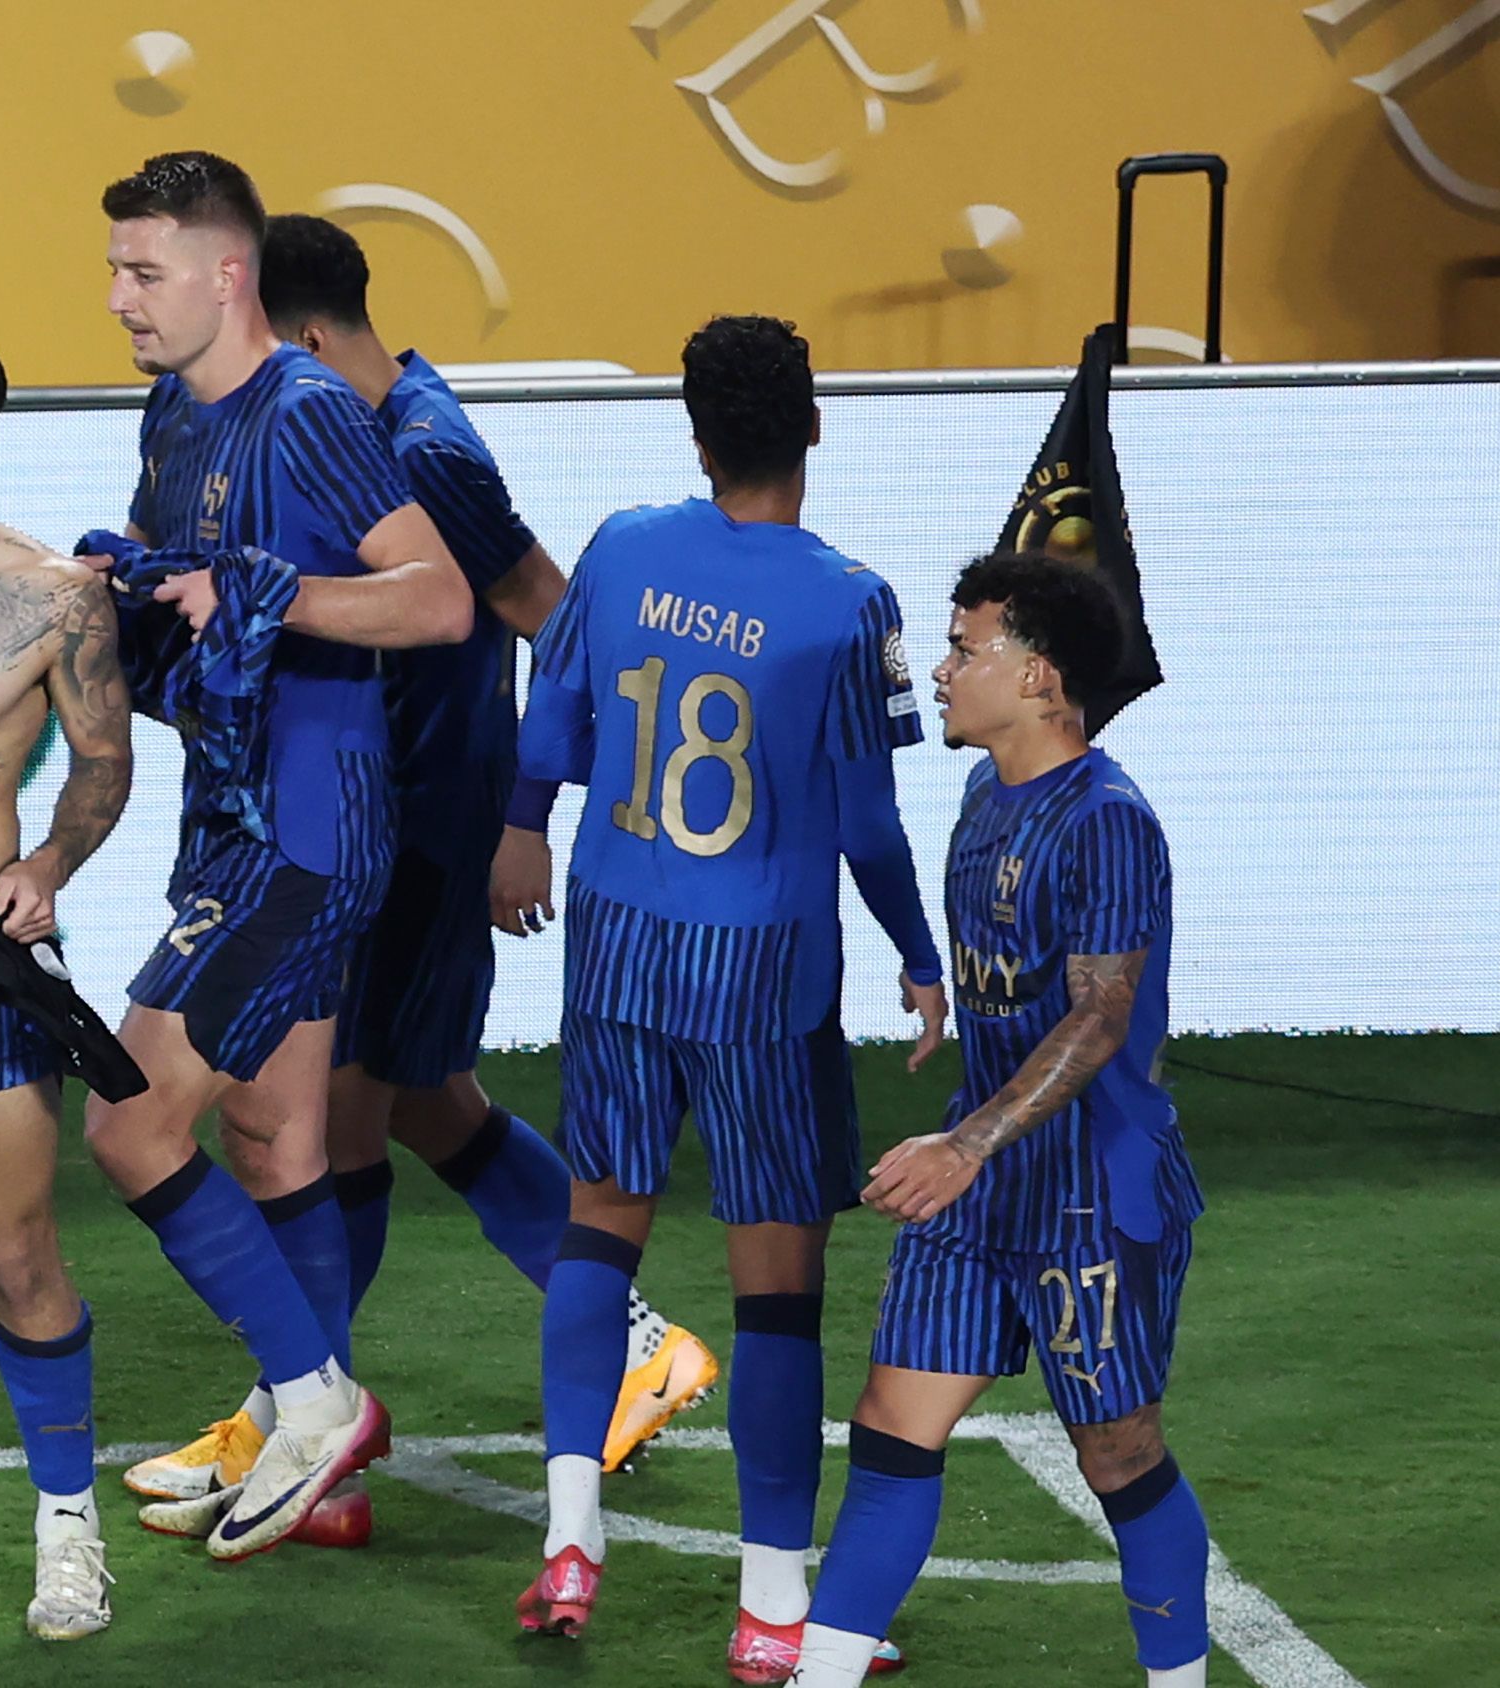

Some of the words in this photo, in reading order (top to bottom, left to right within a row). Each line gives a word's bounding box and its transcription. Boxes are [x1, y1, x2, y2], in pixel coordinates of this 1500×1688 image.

[638, 587, 765, 657] MUSAB
[611, 656, 753, 857] 18
[1039, 1259, 1116, 1353] 27
